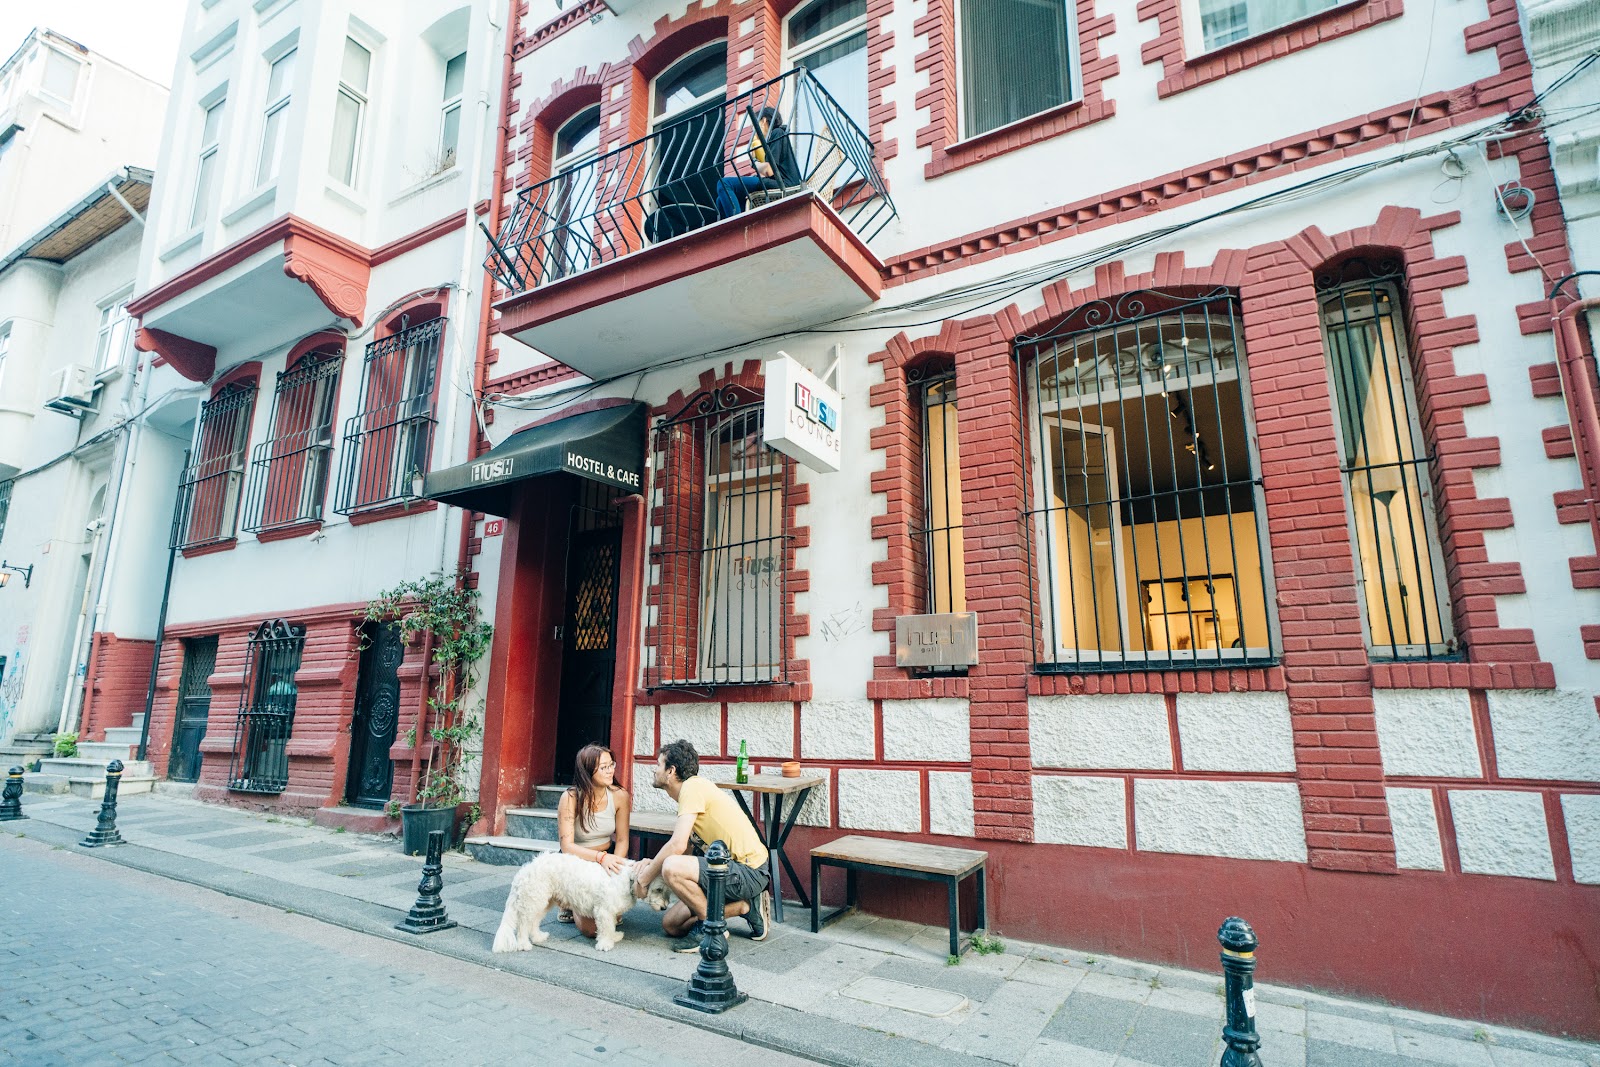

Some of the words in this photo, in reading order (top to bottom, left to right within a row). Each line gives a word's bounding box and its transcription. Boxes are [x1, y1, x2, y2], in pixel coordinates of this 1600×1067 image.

[795, 382, 837, 432] HUSH
[790, 409, 840, 452] LOUNGE
[471, 458, 514, 482] HUSH
[567, 452, 605, 476] HOSTEL
[607, 465, 615, 479] &
[617, 469, 639, 487] CAFE
[487, 522, 499, 534] 46
[727, 576, 781, 591] OUN
